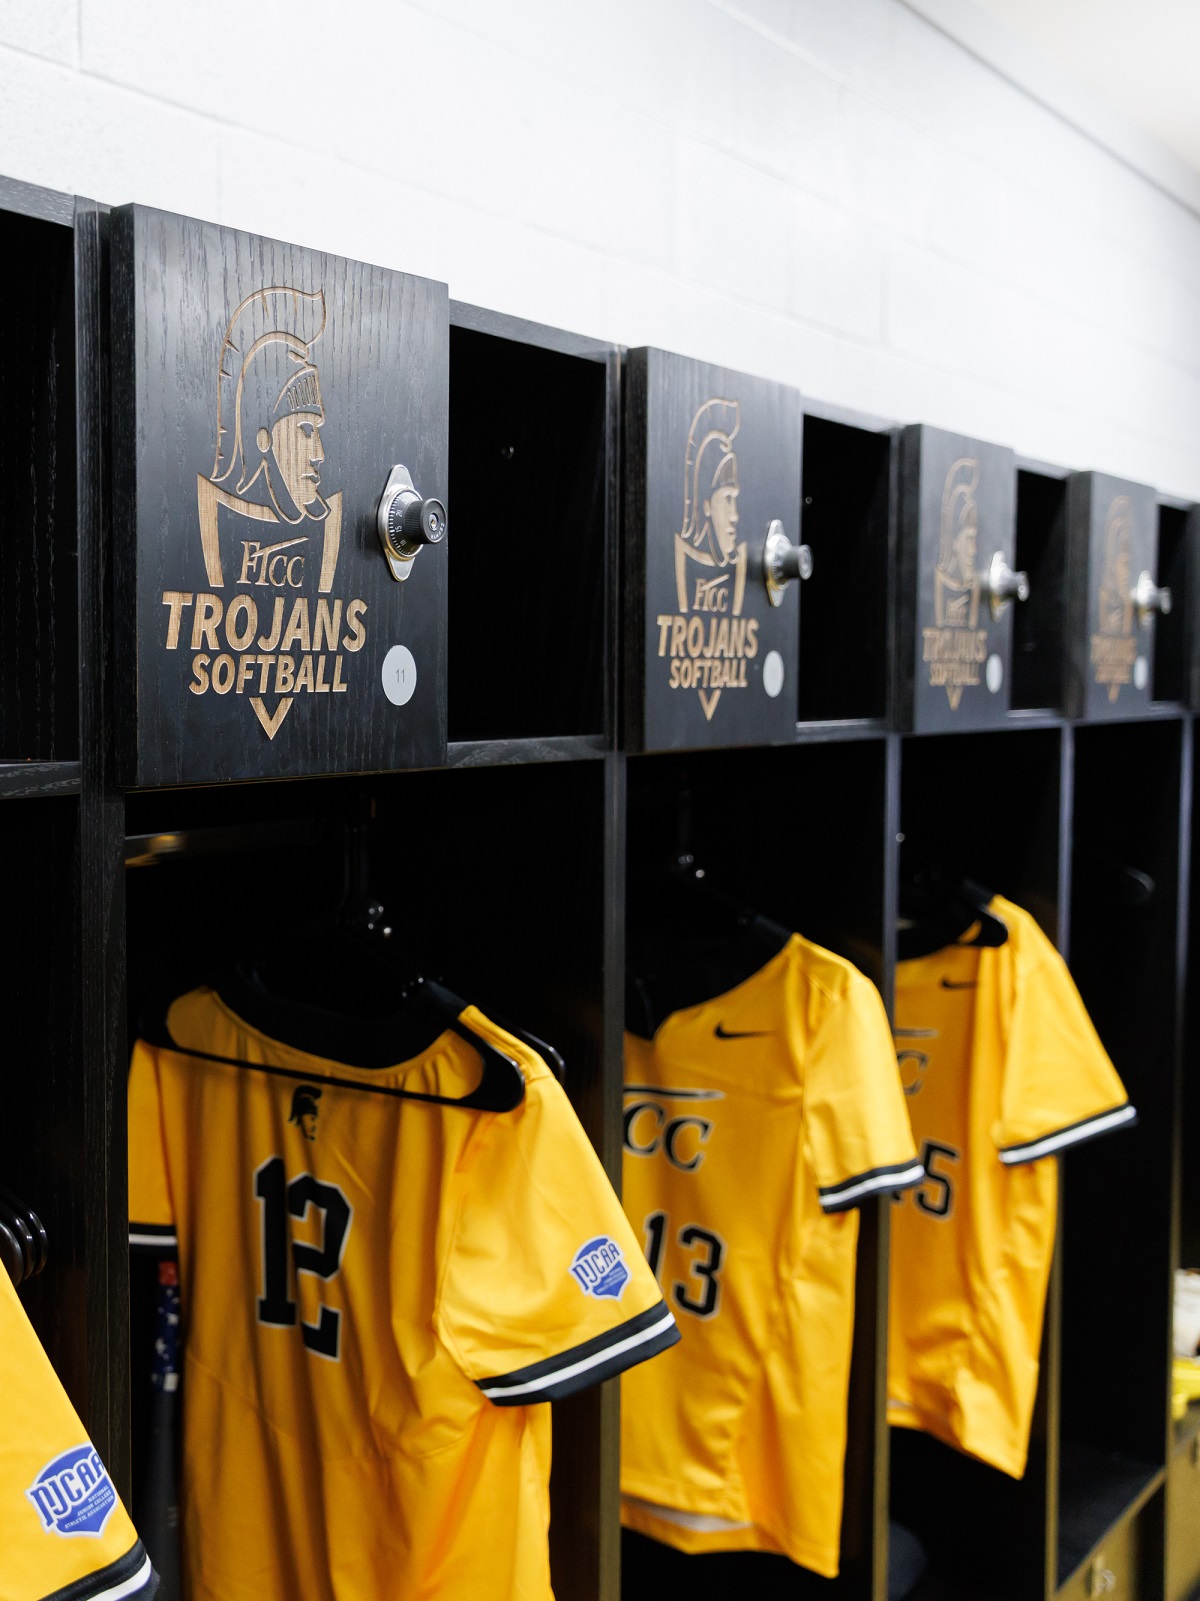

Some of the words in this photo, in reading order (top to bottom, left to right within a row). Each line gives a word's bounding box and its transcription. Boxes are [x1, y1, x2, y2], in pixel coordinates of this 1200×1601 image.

[236, 536, 309, 588] FTCC
[161, 590, 368, 652] TROJANS
[657, 614, 760, 660] TROJANS
[188, 653, 347, 695] SOFTBALL
[395, 668, 405, 684] 11
[668, 658, 748, 689] SOFTBALL
[623, 1086, 722, 1171] CC
[893, 1139, 960, 1219] 5
[253, 1154, 354, 1362] 12
[572, 1243, 620, 1291] NJCAA
[645, 1211, 727, 1318] 13
